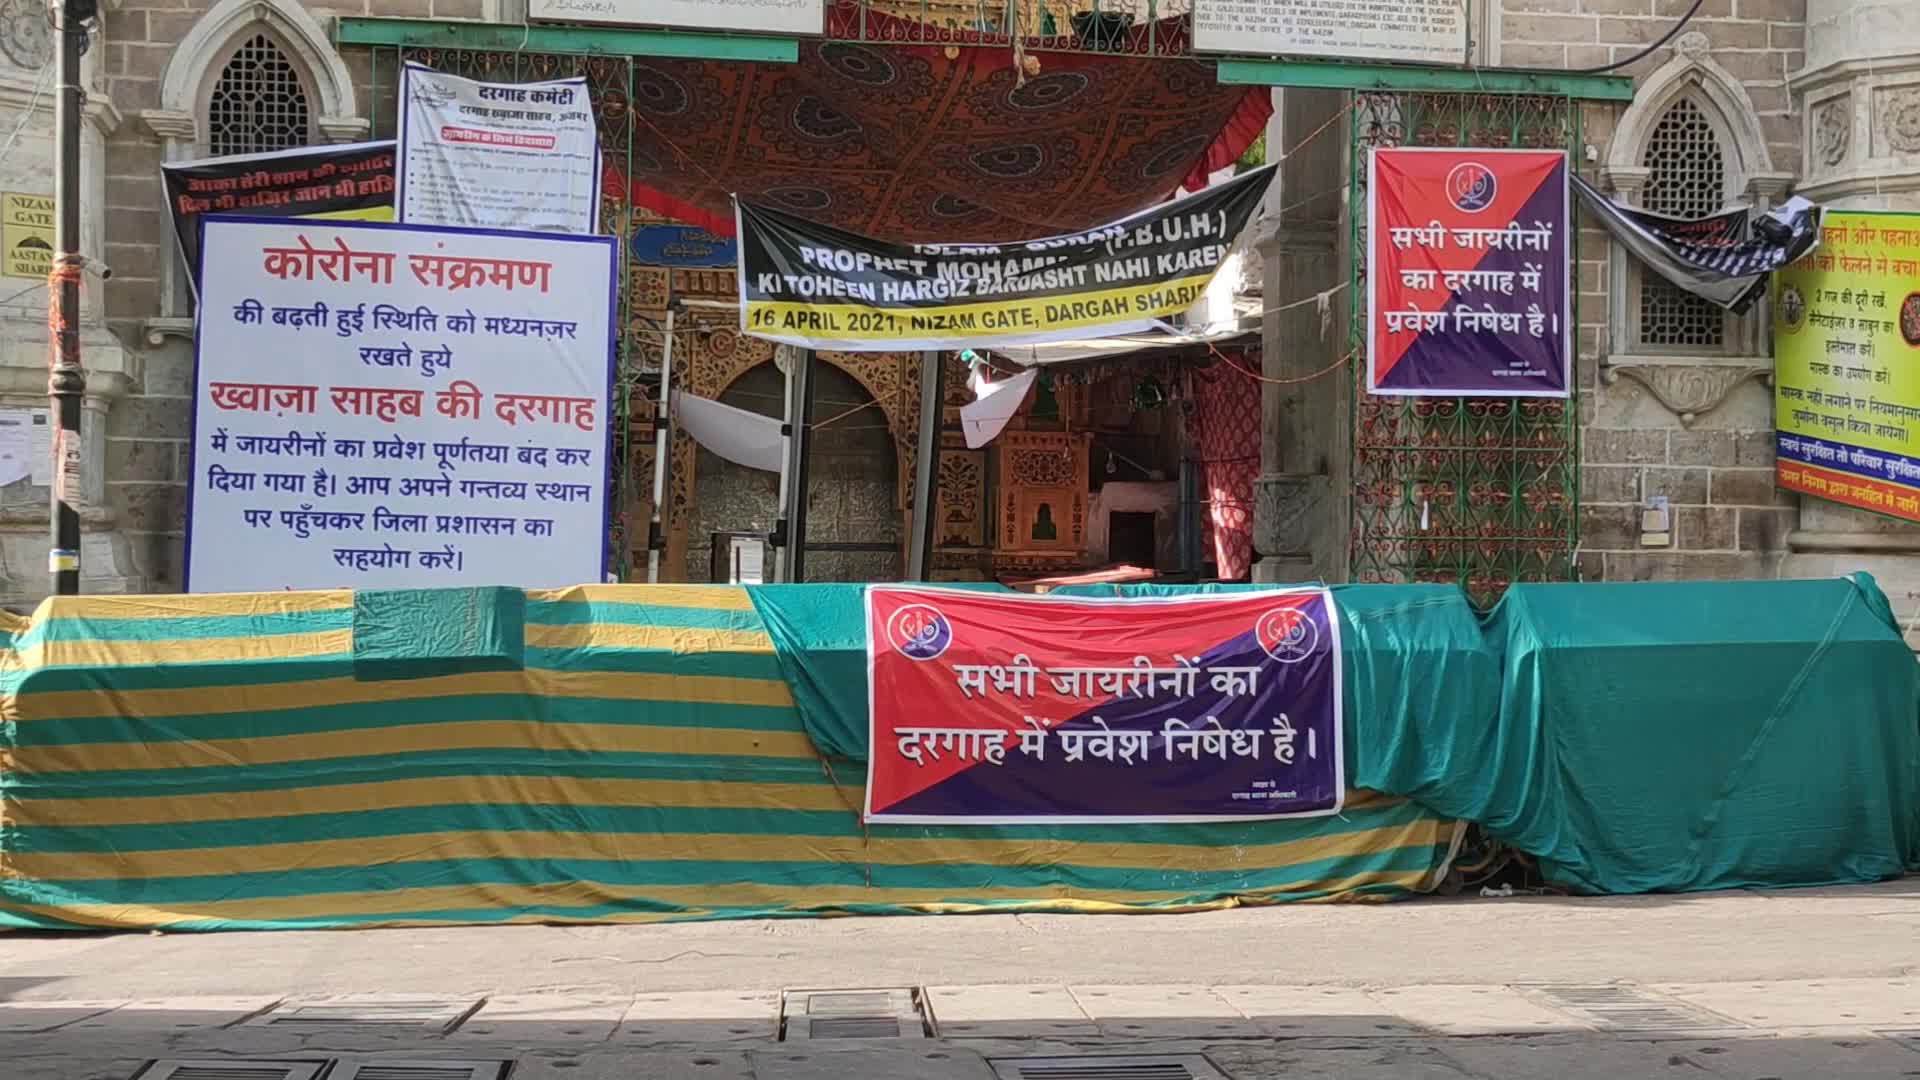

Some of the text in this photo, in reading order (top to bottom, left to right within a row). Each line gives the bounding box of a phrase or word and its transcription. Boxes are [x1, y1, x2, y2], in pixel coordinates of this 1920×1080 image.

[479, 86, 574, 105] दरगाह कमेटी
[15, 211, 53, 225] GATE
[1390, 220, 1553, 251] सभी जायरीनों
[263, 234, 552, 292] कोरोना संक्रमण
[799, 246, 928, 276] PROPHET
[758, 272, 782, 294] KI
[783, 274, 876, 301] TOHEEN
[883, 278, 971, 301] HARGIZ
[1095, 257, 1150, 283] NAHI
[1400, 262, 1543, 296] का दरगाह में
[1841, 288, 1852, 304] की
[233, 298, 577, 341] की बढ़ती हुई स्थिति को मध्यनज़र
[752, 308, 775, 326] 16
[783, 311, 840, 331] APRIL
[847, 312, 904, 335] 2021,
[911, 313, 976, 330] NIZAM
[981, 307, 1040, 329] GATE,
[1045, 296, 1129, 323] DARGAH
[1384, 301, 1448, 336] प्रवेश
[1453, 303, 1523, 334] निषेध
[359, 341, 453, 377] रखते हुये
[1832, 365, 1843, 378] का
[210, 380, 596, 431] ख्वाज़ा साहब की दरगाह
[1854, 398, 1866, 410] पर
[210, 427, 591, 471] में जायरीनों का प्रवेश पूर्णतया बंद कर
[1837, 445, 1848, 464] तो
[1851, 449, 1883, 471] परिवार
[208, 464, 591, 503] दिया गया है। आप अपने गन्तव्य स्थान
[244, 503, 554, 538] पर पहुँचकर जिला प्रशासन का
[333, 542, 462, 571] सहयोग करें।
[952, 653, 1262, 699] सभी जायरीनों का
[894, 727, 1008, 766] दरगाह
[1016, 715, 1052, 761] में
[1056, 716, 1153, 765] प्रवेश
[1160, 716, 1265, 761] निषेध
